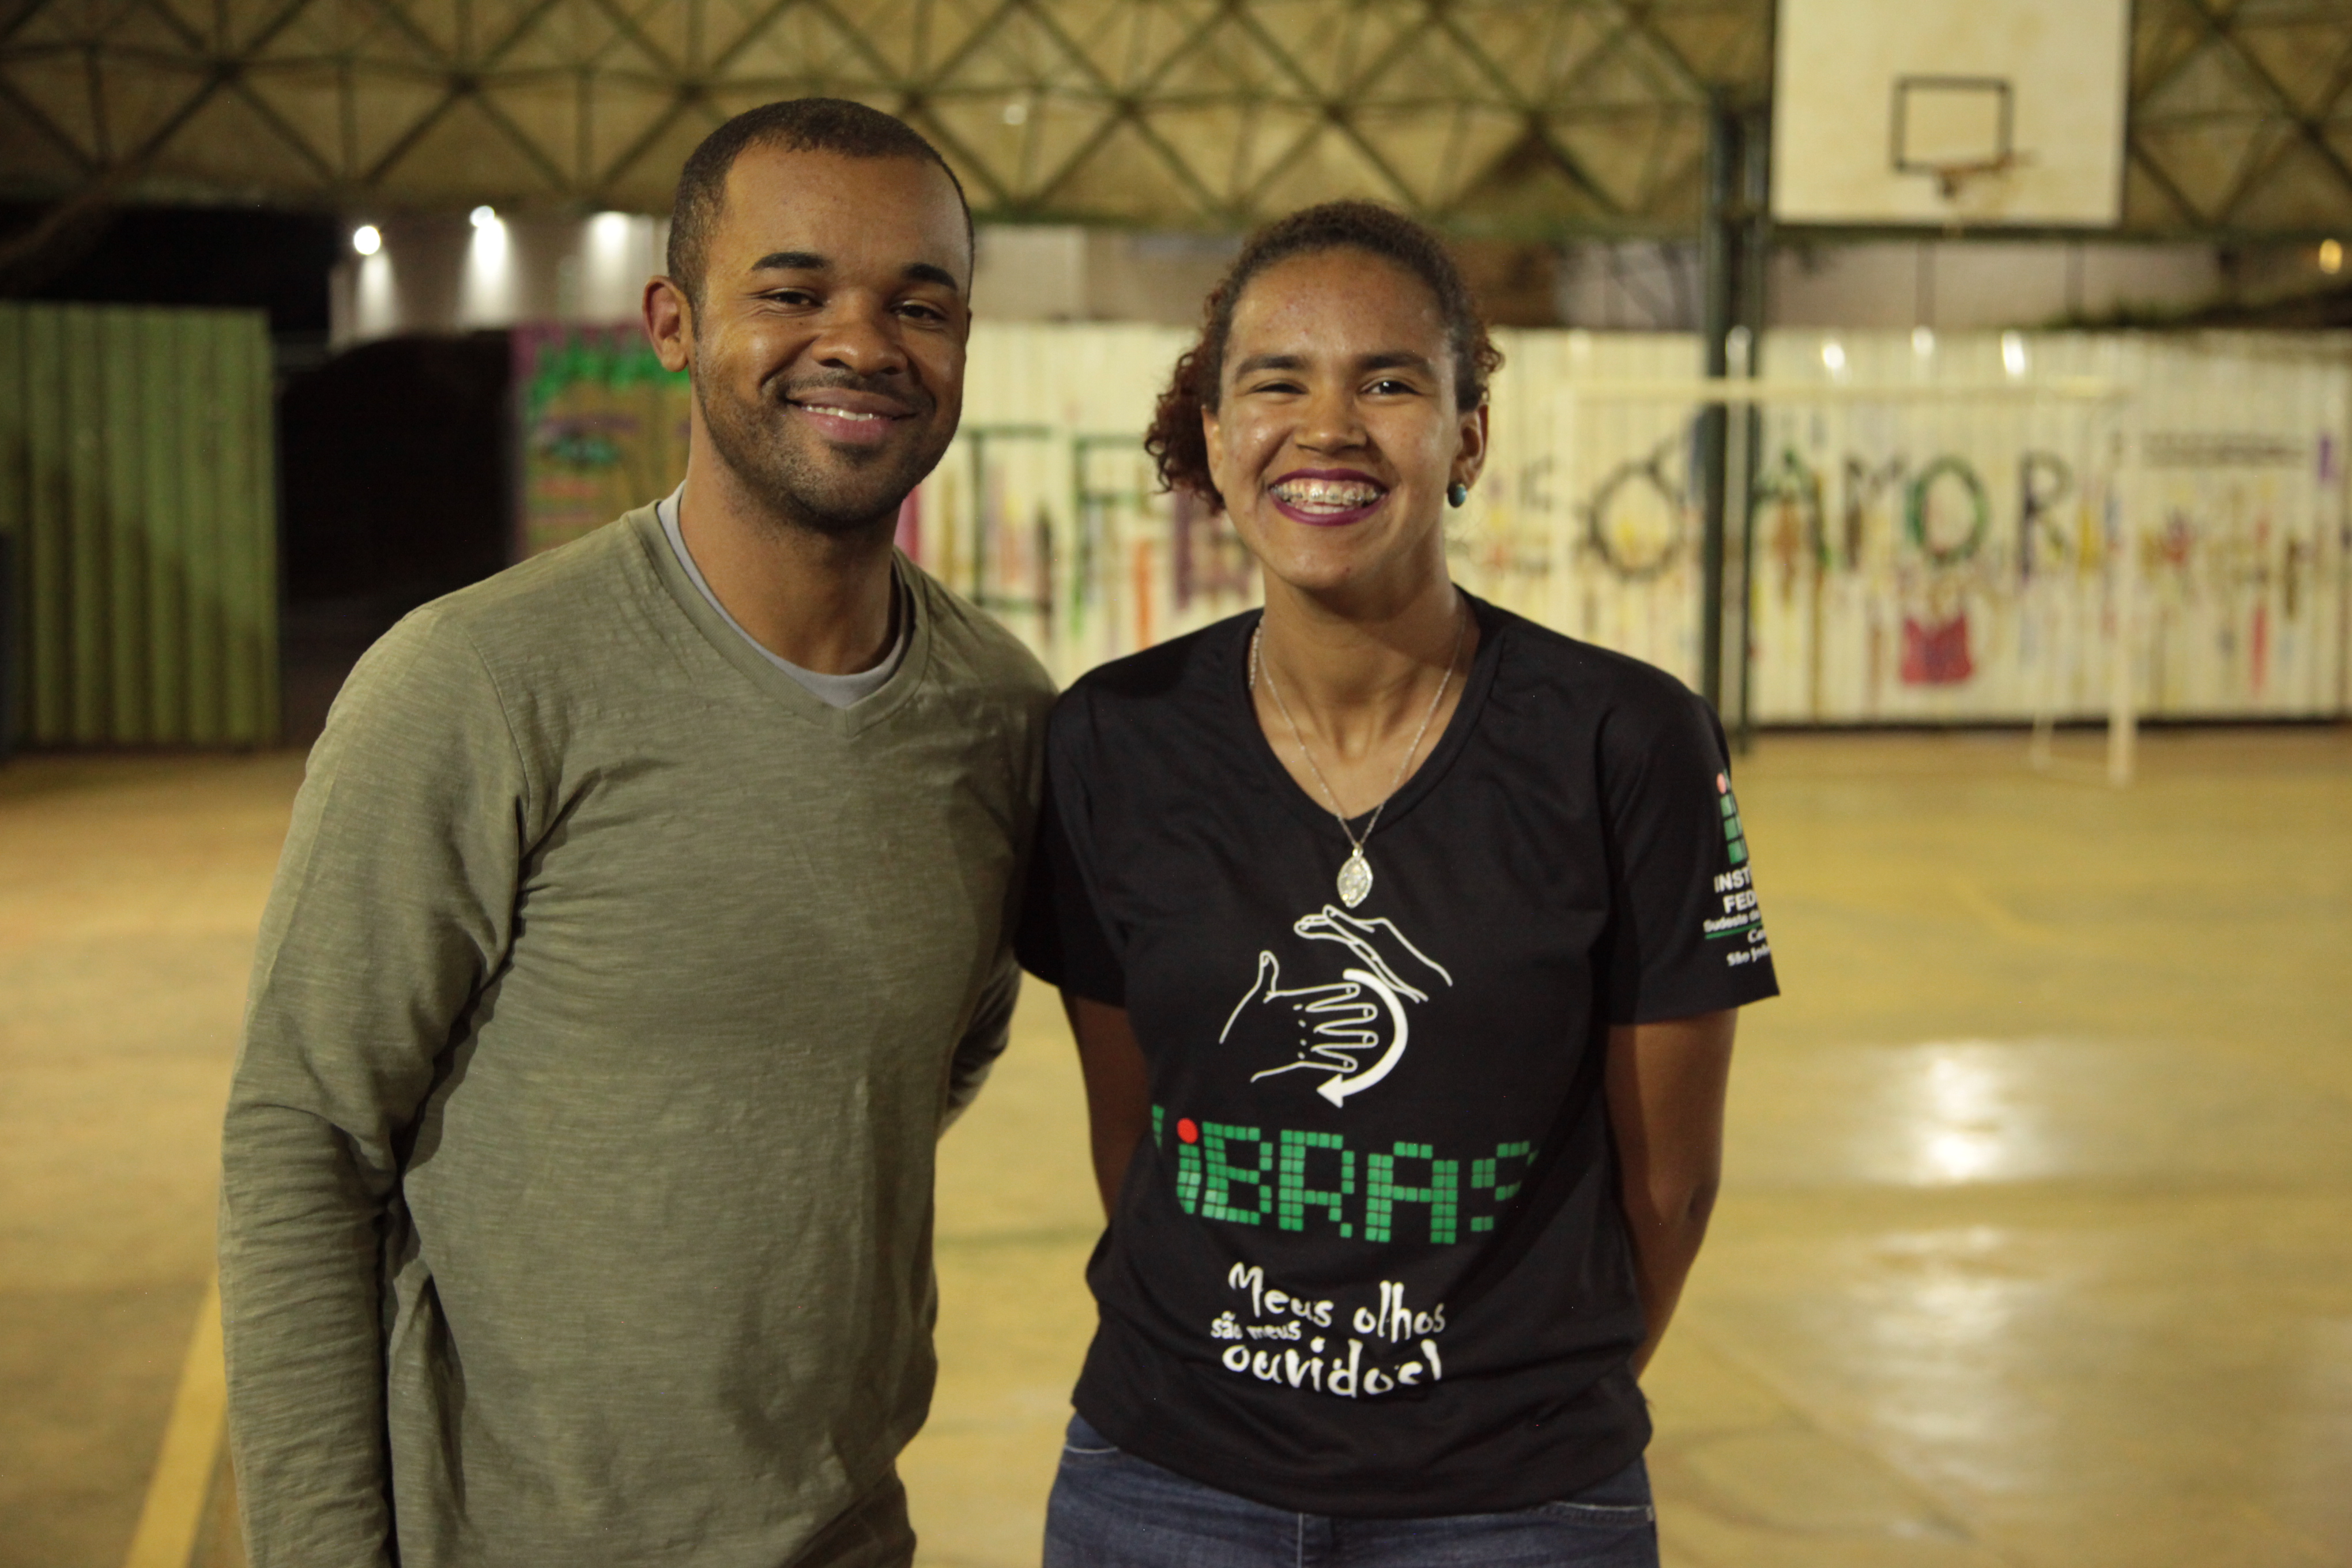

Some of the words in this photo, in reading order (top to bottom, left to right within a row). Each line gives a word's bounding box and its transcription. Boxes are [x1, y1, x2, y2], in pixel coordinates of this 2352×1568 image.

[1228, 1261, 1334, 1328] Meus
[1353, 1280, 1445, 1343] olhos
[1246, 1320, 1302, 1341] meus
